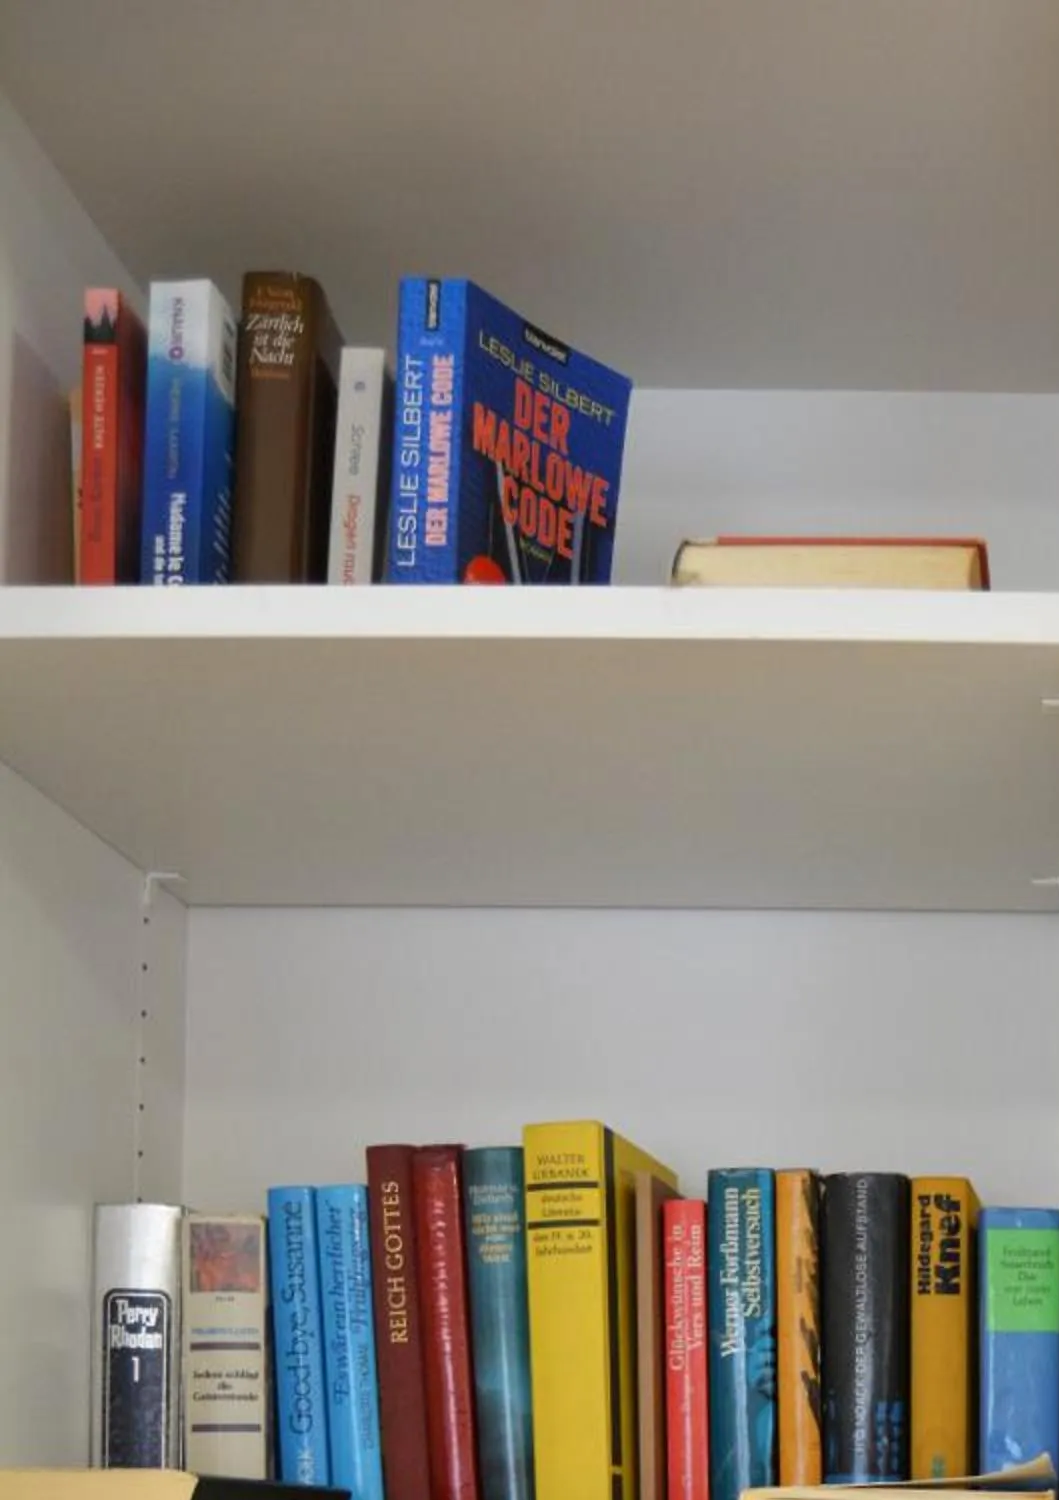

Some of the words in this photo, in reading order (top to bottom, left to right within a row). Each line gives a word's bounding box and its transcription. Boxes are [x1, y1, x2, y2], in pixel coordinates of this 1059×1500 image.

[246, 313, 304, 334] Zärtlich
[249, 346, 294, 365] Nacht
[402, 355, 423, 468] SILBERT
[431, 354, 455, 406] CODE
[479, 330, 534, 381] LESLIE
[539, 372, 619, 427] SILBERT
[514, 378, 571, 456] DER
[427, 410, 452, 502] MARLOWE
[472, 401, 610, 527] MARLOWE
[167, 492, 187, 554] Madame
[397, 481, 419, 567] LESLIE
[425, 507, 448, 547] DER
[501, 475, 574, 560] CODE
[171, 557, 186, 571] le
[281, 1200, 306, 1303] Susanne
[381, 1180, 405, 1271] GOTTES
[688, 1224, 703, 1268] Reim
[720, 1186, 740, 1286] Forßmann
[742, 1187, 763, 1318] Selbstversuch
[856, 1179, 868, 1252] AUFSTAND
[917, 1194, 933, 1296] Hildegard
[934, 1193, 961, 1296] Knef
[116, 1300, 159, 1328] Perry
[387, 1275, 409, 1345] REICH
[668, 1244, 685, 1371] Glückwünsche
[688, 1274, 703, 1308] und
[721, 1288, 740, 1358] Werner
[855, 1255, 868, 1342] GEWALTLOSE
[110, 1323, 163, 1350] Rhodan
[687, 1312, 703, 1350] Vers
[130, 1356, 141, 1382] 1
